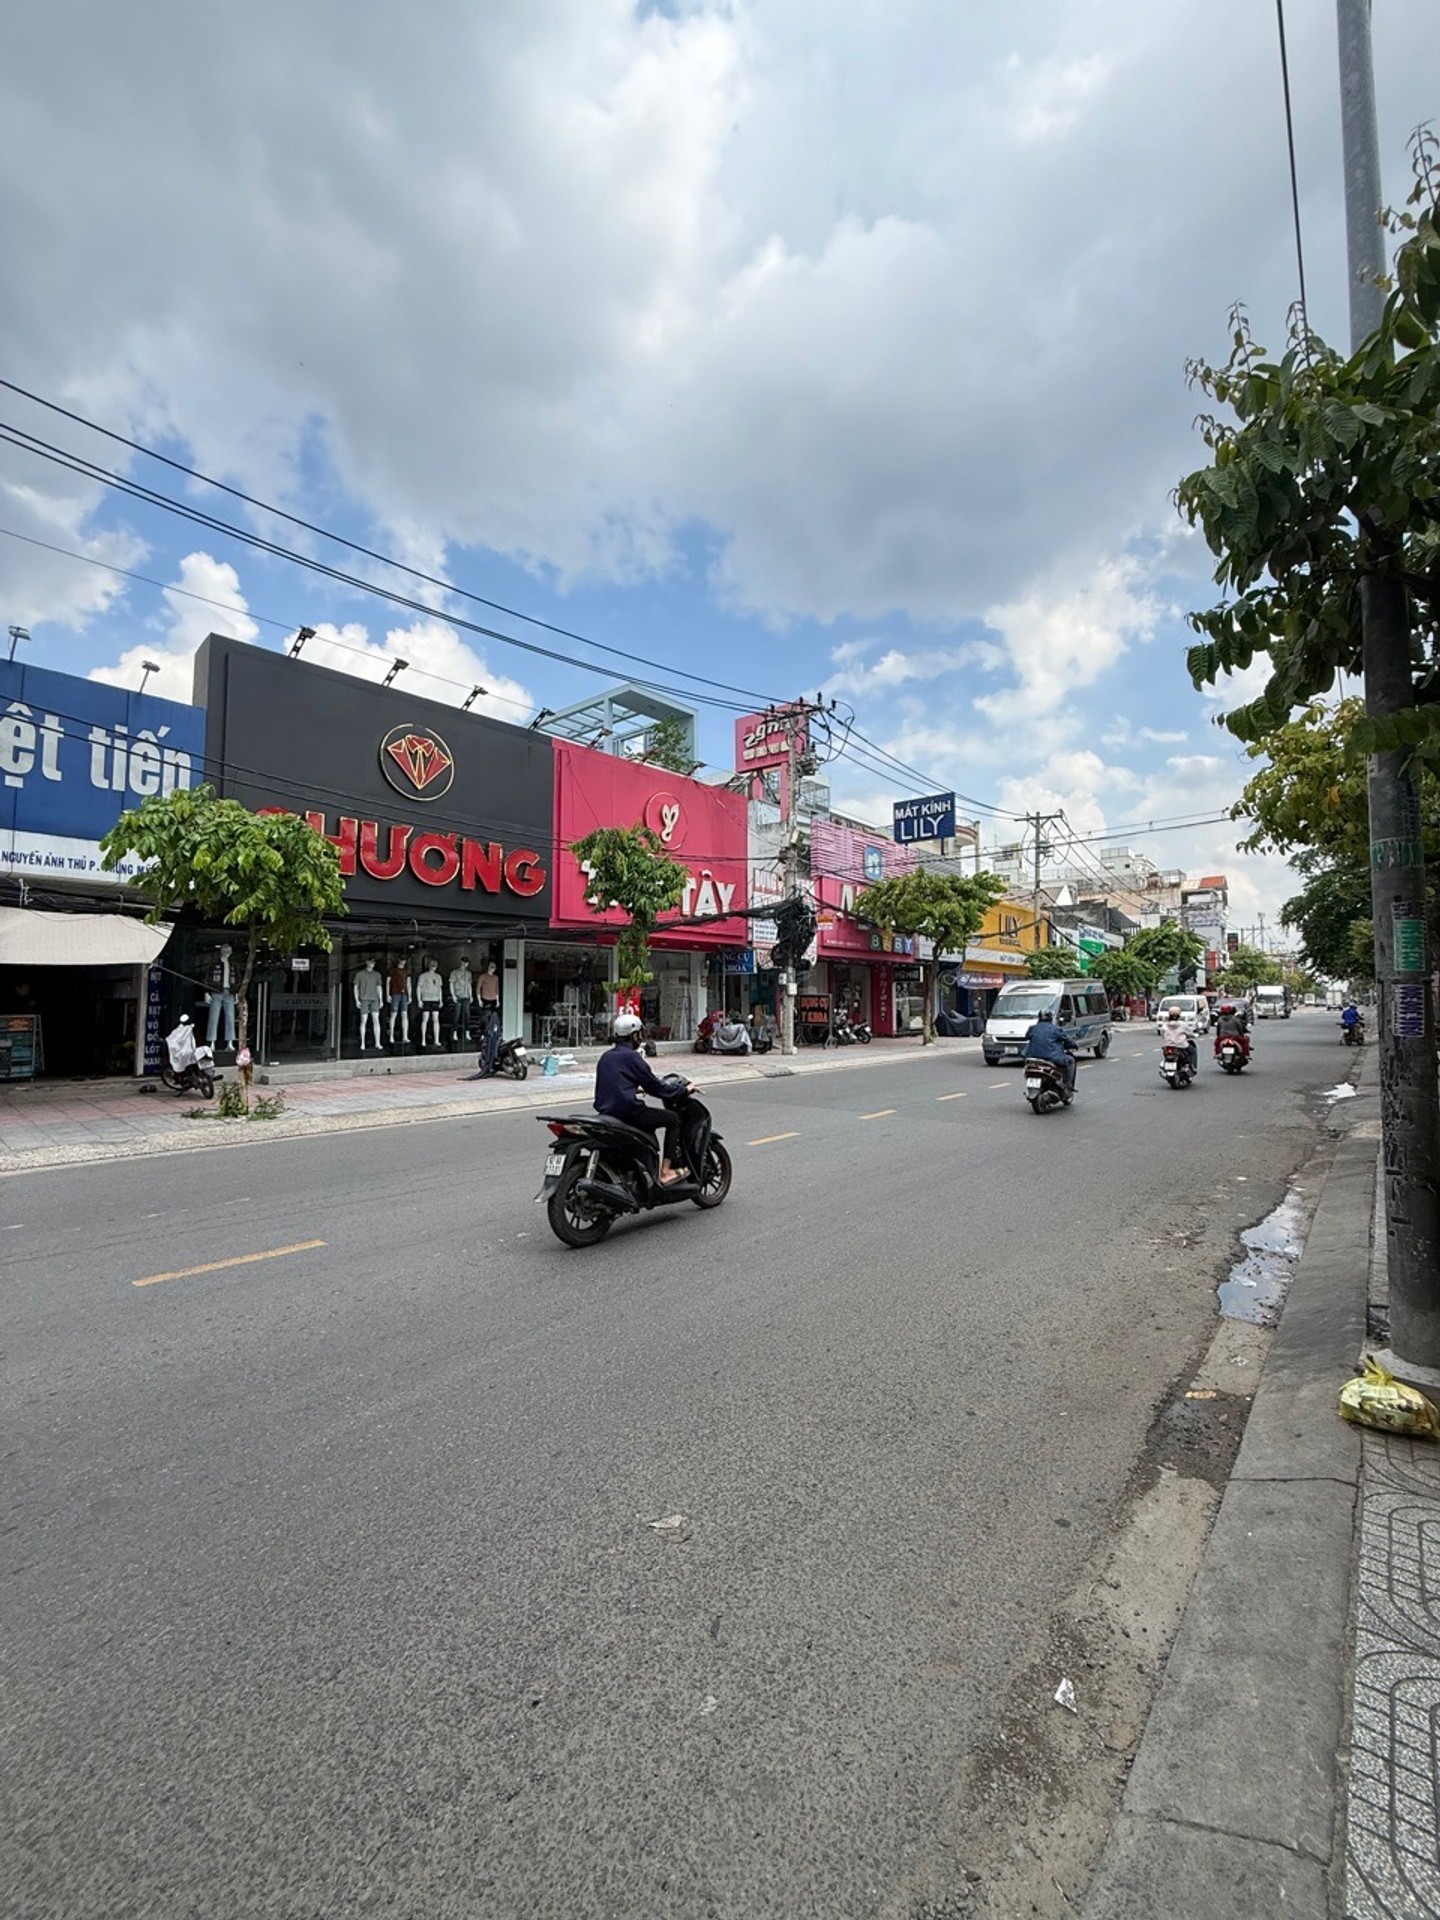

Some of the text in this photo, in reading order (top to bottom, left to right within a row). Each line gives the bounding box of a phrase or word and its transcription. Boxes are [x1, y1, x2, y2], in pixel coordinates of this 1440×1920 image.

[89, 724, 192, 798] tiến
[921, 800, 951, 816] KÍNH
[901, 814, 944, 840] LILY
[2, 851, 42, 866] NGUYỄN
[255, 806, 548, 897] HƯƠNG
[682, 869, 735, 917] TÂY
